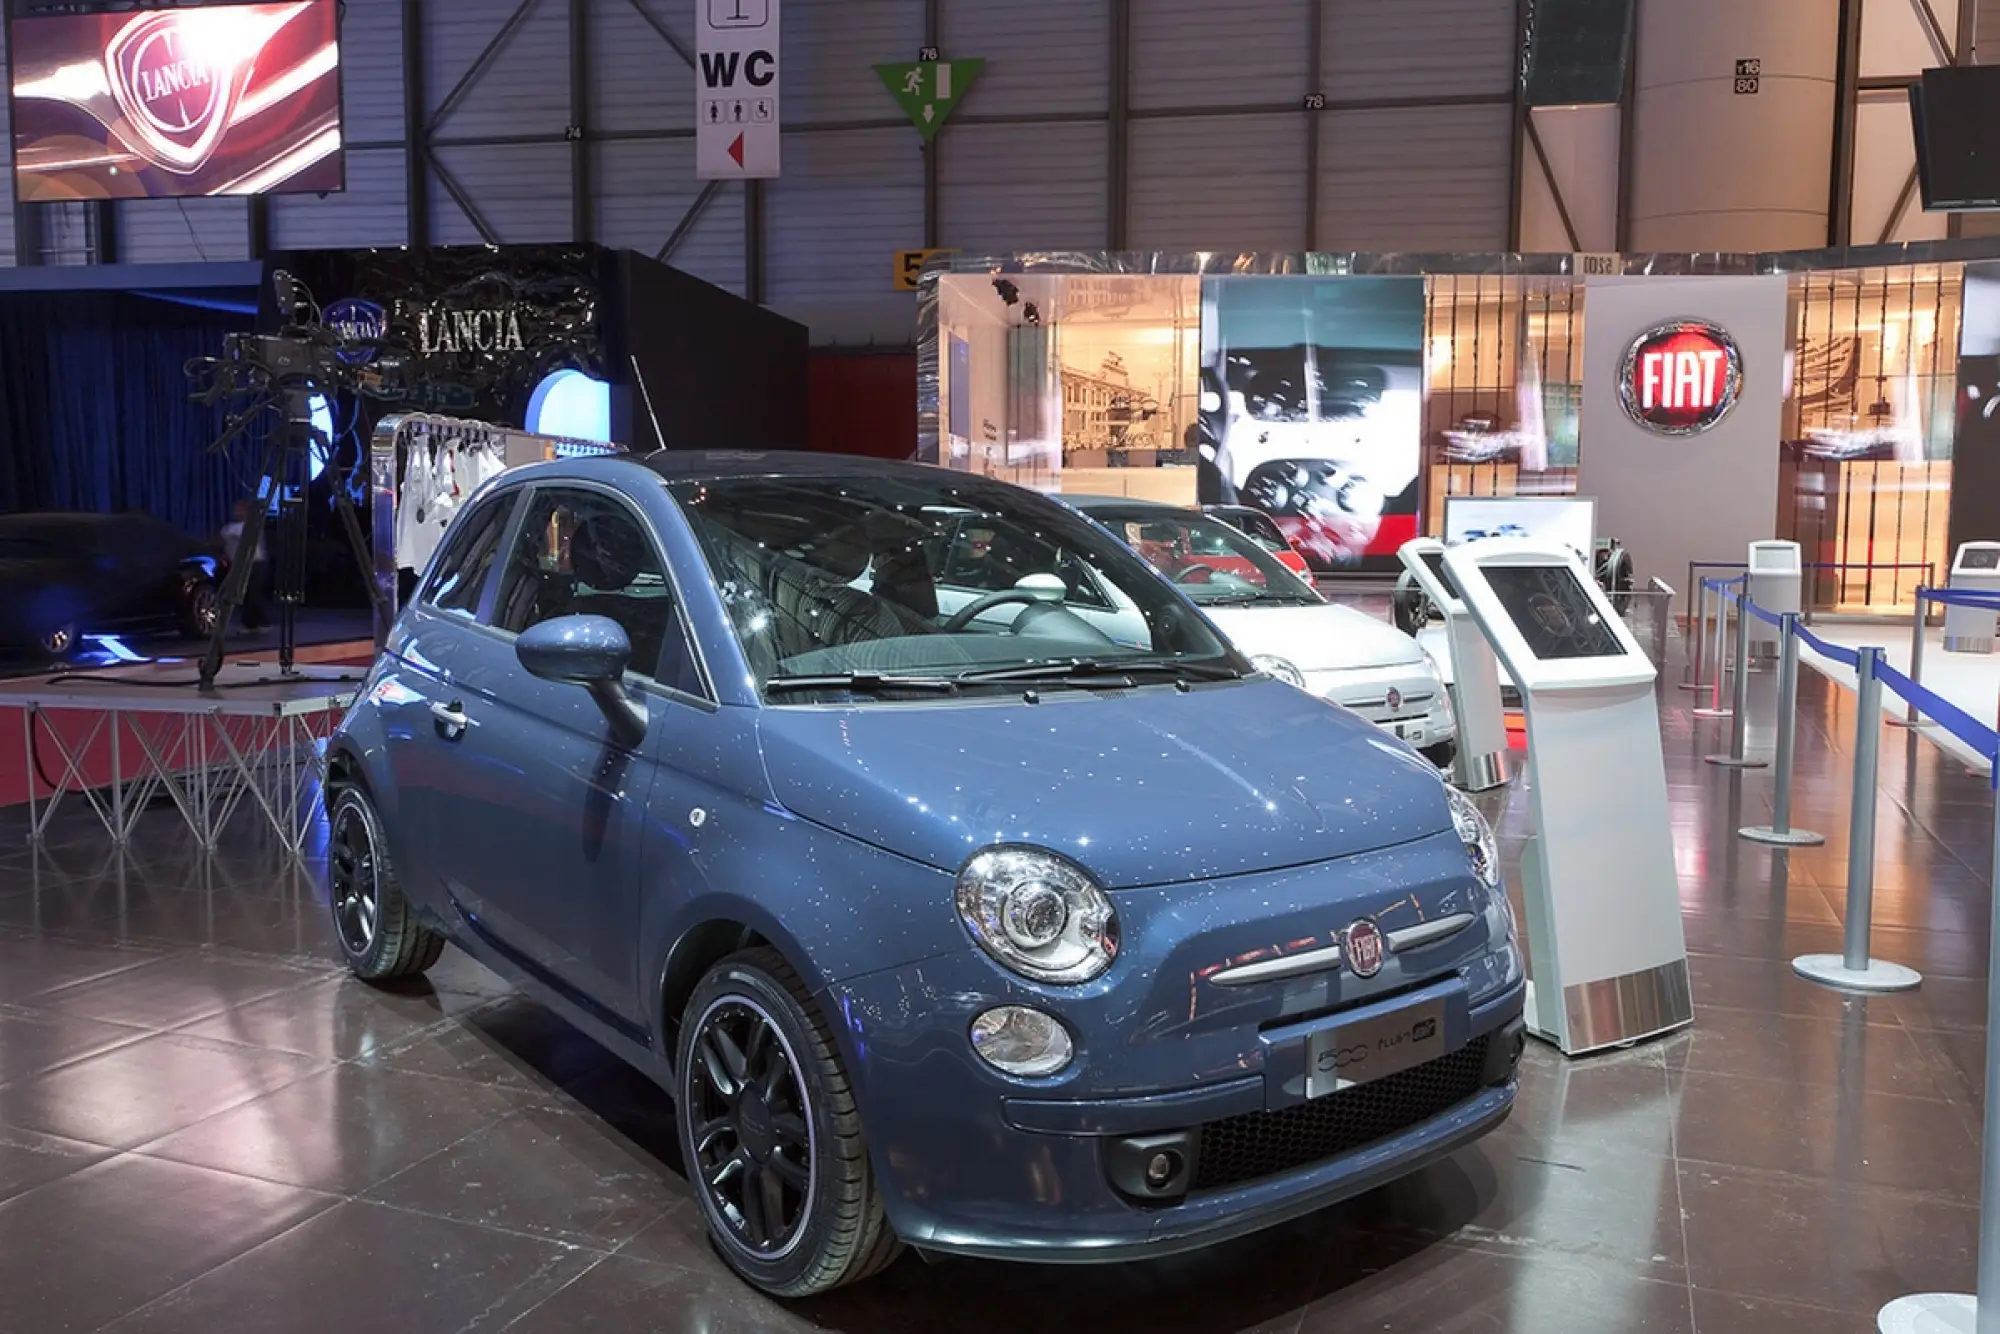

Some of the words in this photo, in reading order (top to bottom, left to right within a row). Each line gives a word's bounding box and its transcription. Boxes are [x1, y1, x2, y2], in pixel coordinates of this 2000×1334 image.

[921, 47, 937, 60] 76
[141, 61, 210, 102] LANCIA
[700, 50, 775, 88] WC
[1736, 79, 1757, 92] 80
[1305, 94, 1323, 108] 78
[419, 308, 525, 353] LANCIA
[1642, 350, 1723, 408] FIAT
[1352, 934, 1377, 964] FIAT
[1317, 1043, 1368, 1072] 500
